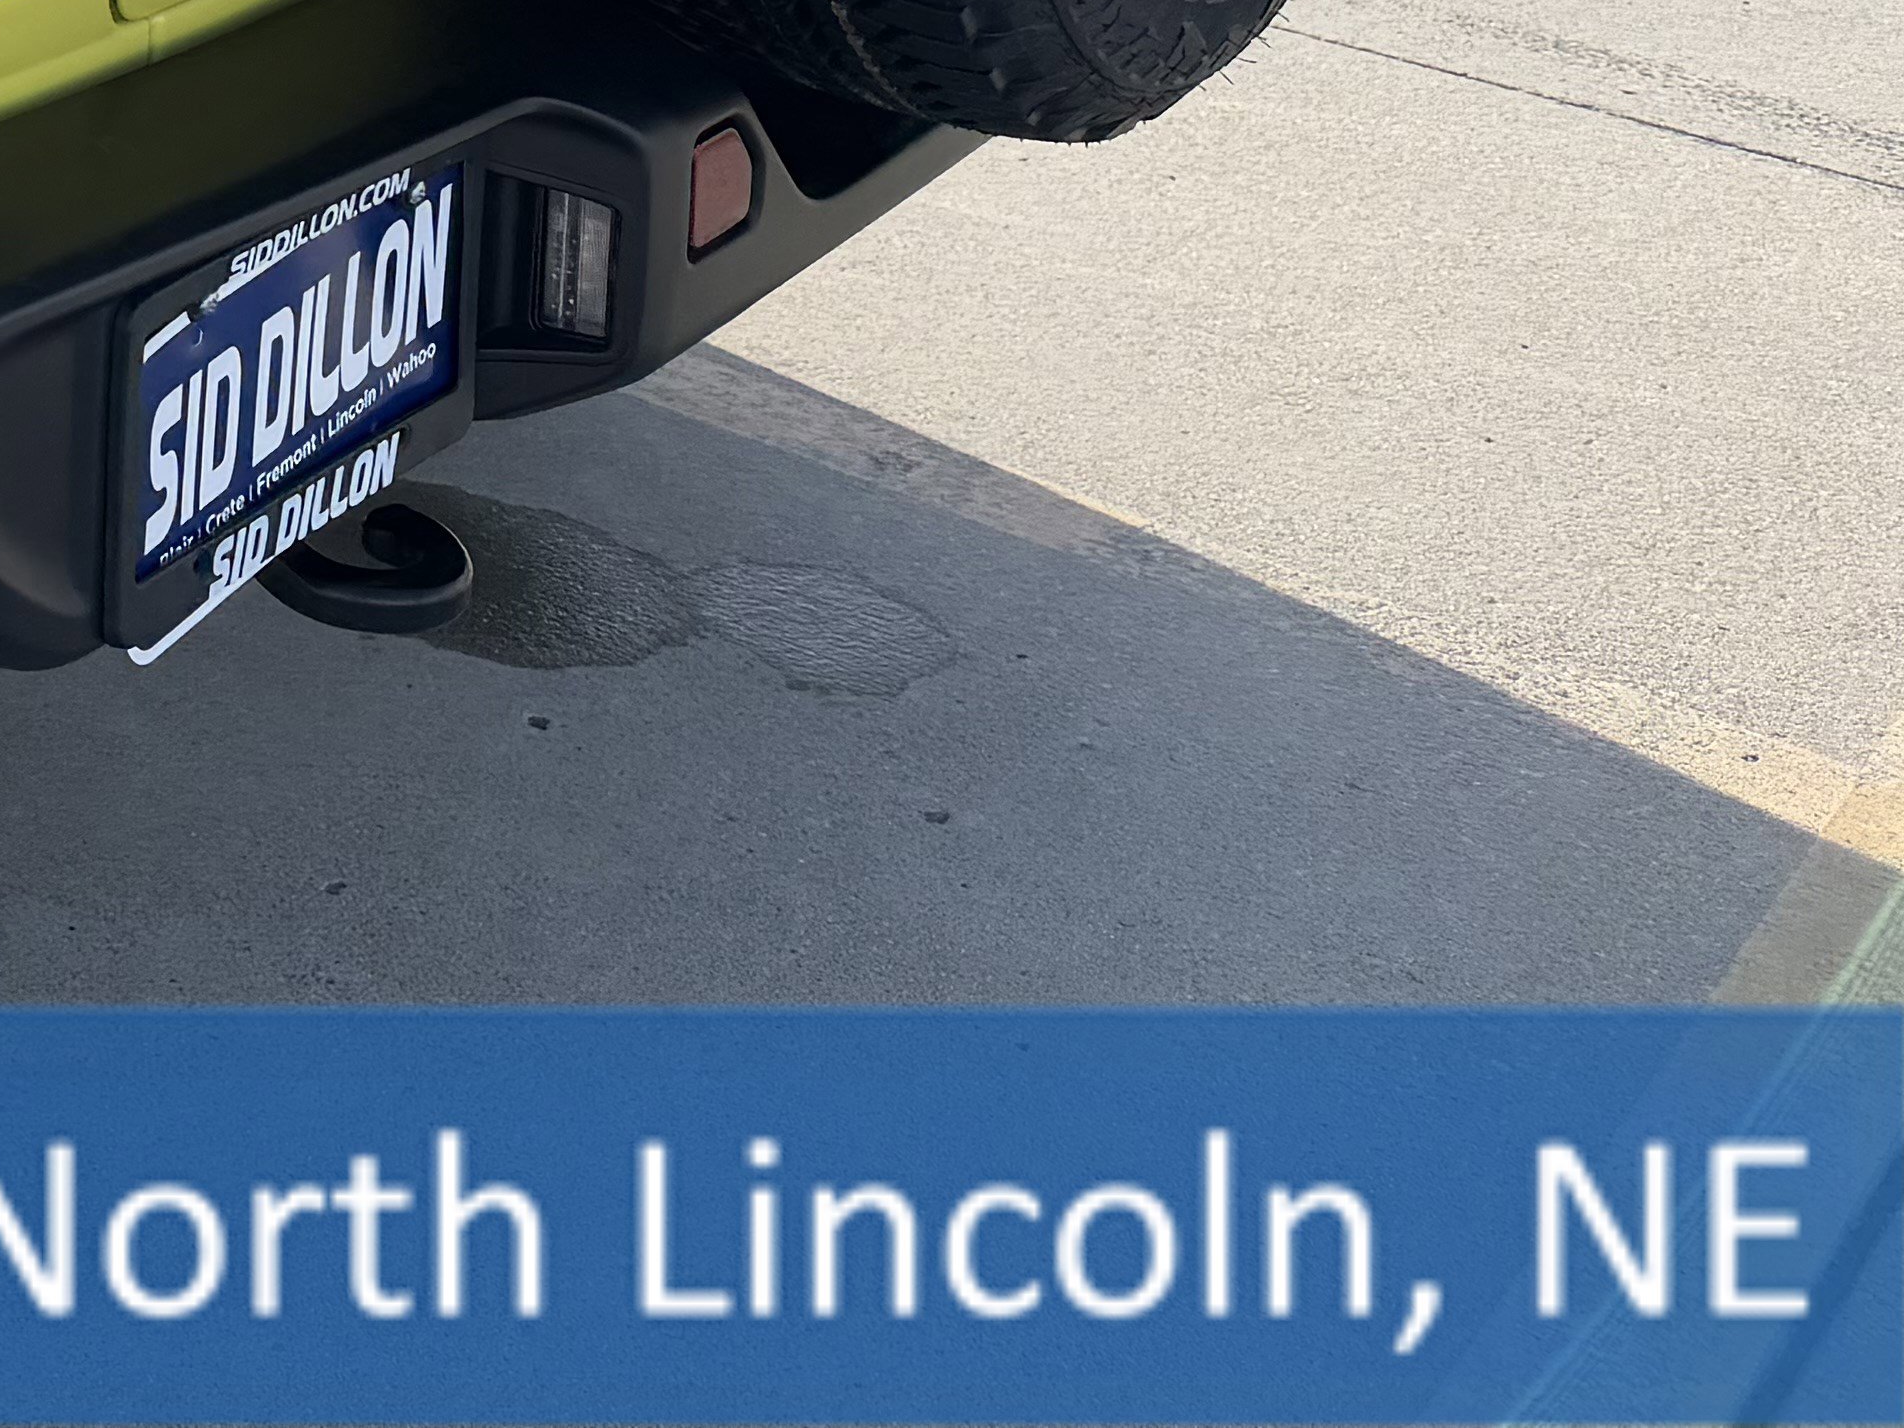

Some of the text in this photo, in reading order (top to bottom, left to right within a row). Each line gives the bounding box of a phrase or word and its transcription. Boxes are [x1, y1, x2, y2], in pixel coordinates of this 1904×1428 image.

[229, 167, 412, 282] SIDDILLON.COM
[143, 182, 453, 556] SID DILLON
[205, 494, 246, 535] Crete
[256, 432, 318, 497] Fremont
[327, 387, 377, 439] Lincoln
[386, 342, 437, 390] Wahoo
[209, 430, 401, 599] SID DILLON
